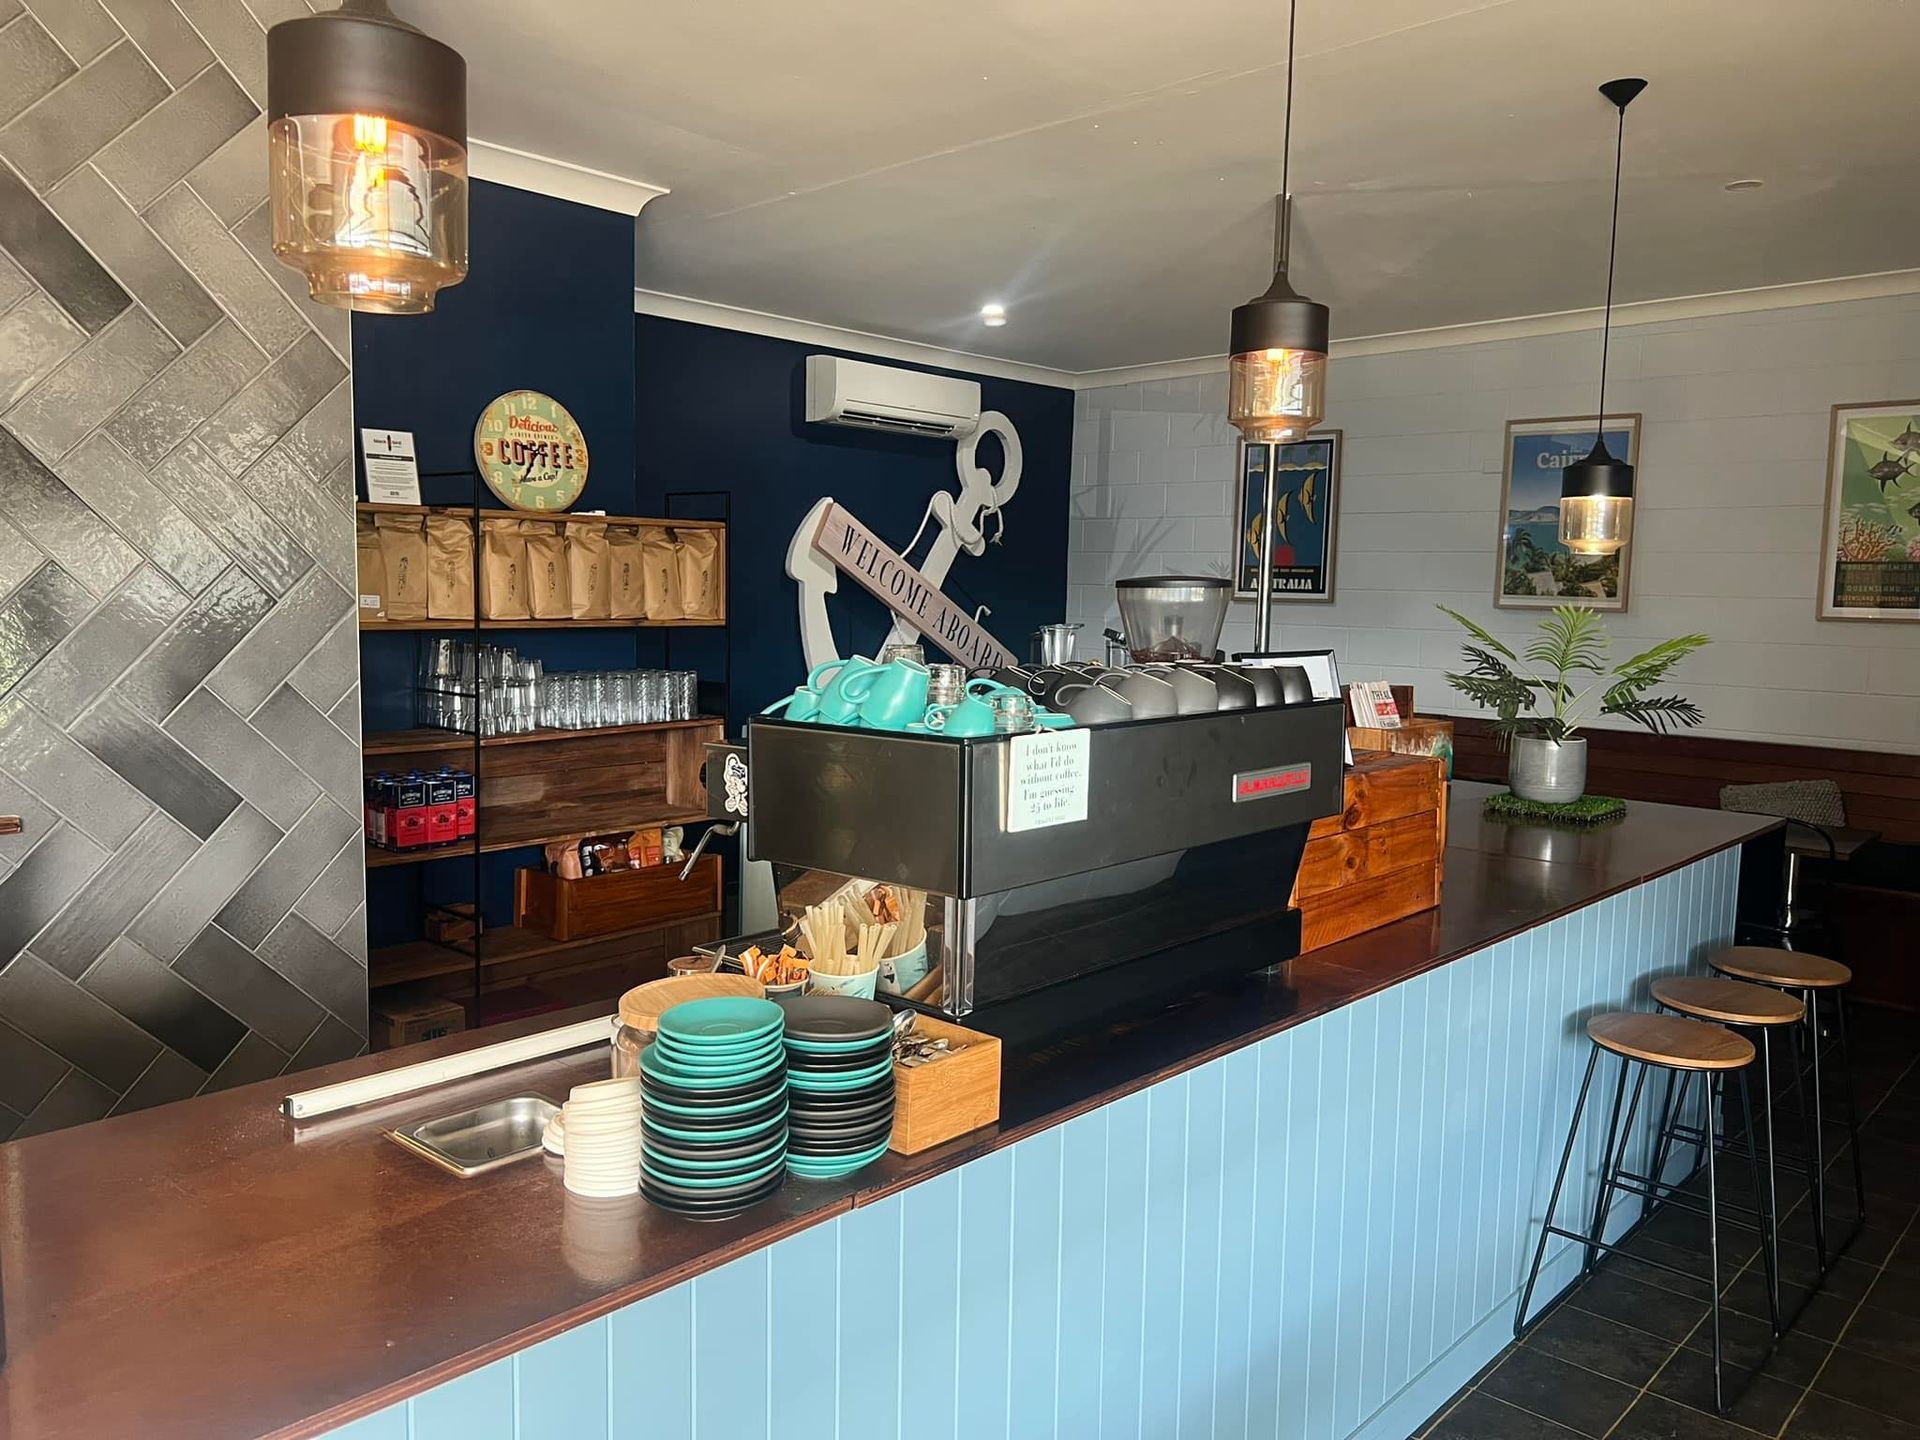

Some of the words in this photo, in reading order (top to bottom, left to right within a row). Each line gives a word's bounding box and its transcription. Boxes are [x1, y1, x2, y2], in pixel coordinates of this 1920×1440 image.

[504, 402, 517, 415] 11
[522, 397, 537, 410] 12
[550, 403, 557, 417] 1
[487, 419, 504, 432] 10
[509, 415, 559, 432] Delicious
[497, 438, 575, 469] COFFEE
[493, 471, 504, 484] 8
[570, 474, 578, 486] 4
[512, 487, 522, 500] 7
[556, 490, 565, 503] 5
[535, 496, 545, 509] 6
[1250, 577, 1313, 590] ATRALIA
[841, 524, 933, 619] WELCOME
[932, 606, 1005, 670] ABOARD
[1025, 744, 1030, 756] I
[1032, 743, 1054, 756] don't
[1056, 741, 1078, 752] know
[1026, 759, 1047, 771] what
[1050, 756, 1061, 769] I'd
[1063, 755, 1075, 766] do
[1020, 773, 1053, 785] without
[1023, 789, 1037, 801] I'm
[1030, 802, 1041, 814] 25
[1043, 800, 1052, 811] to
